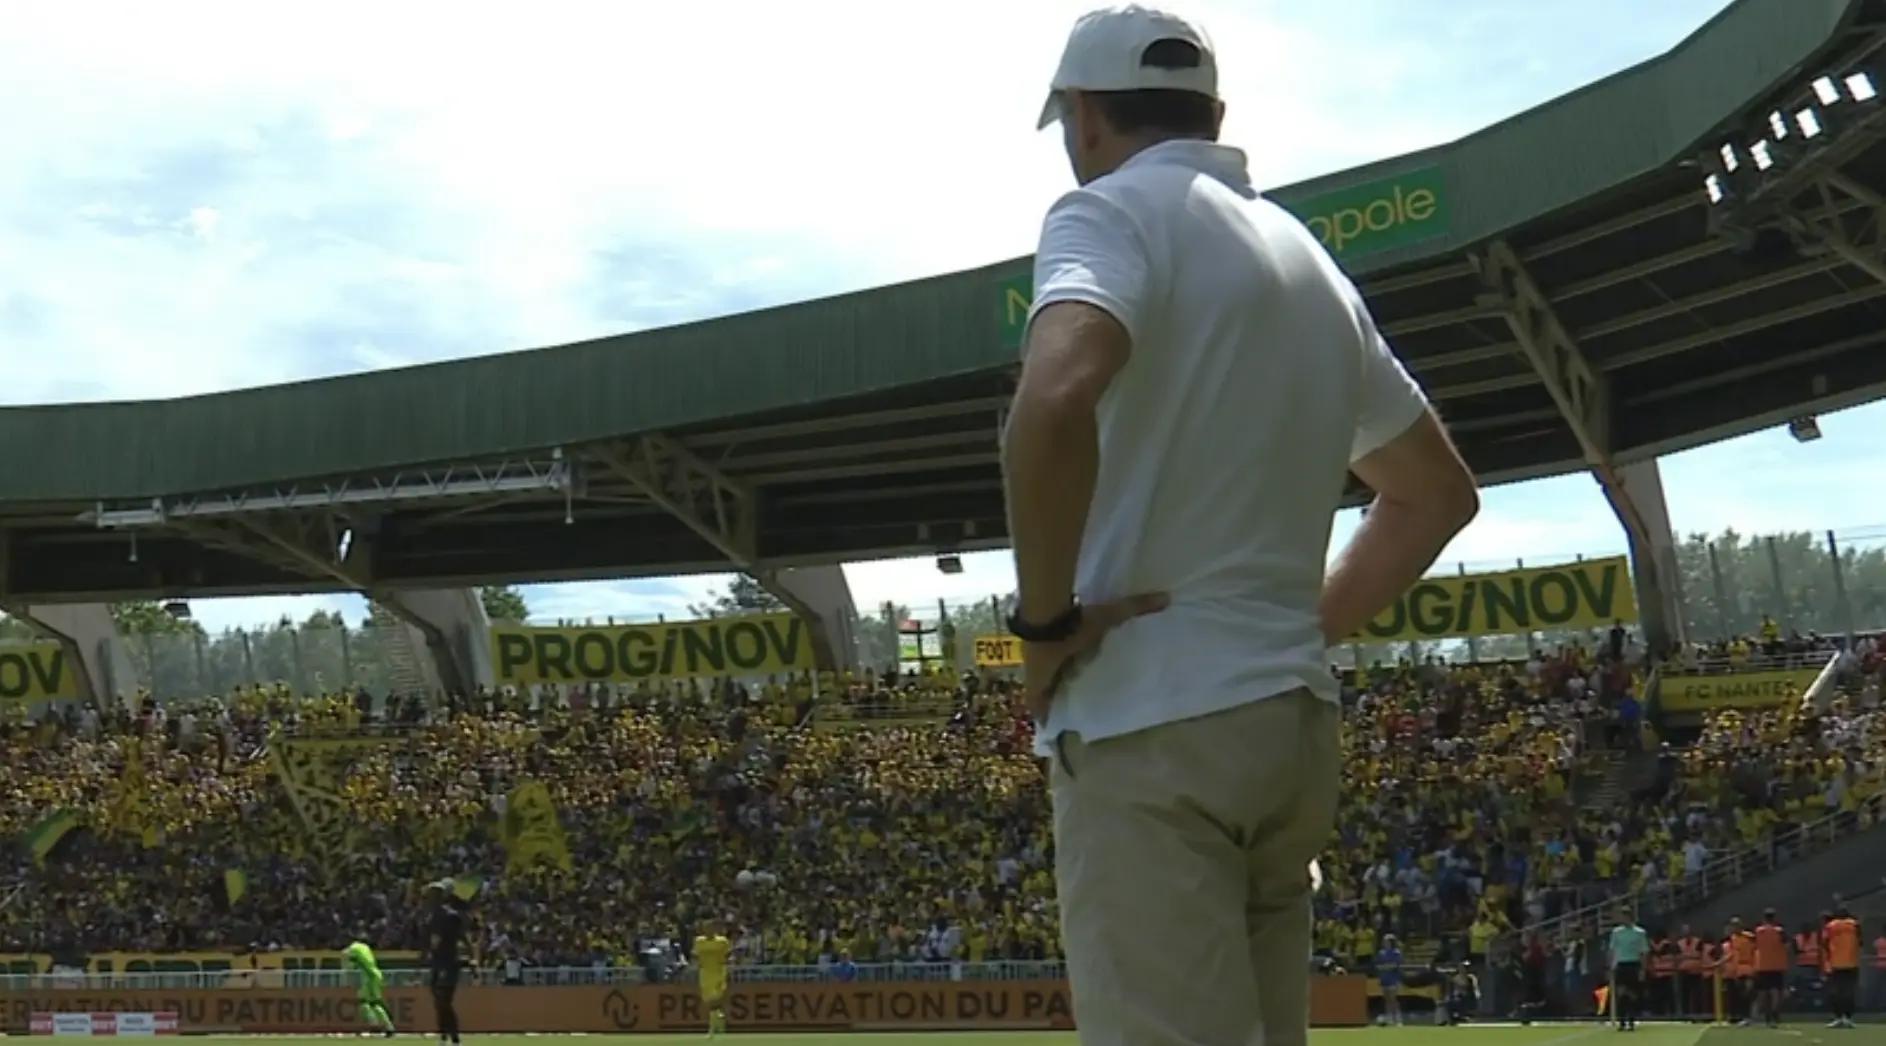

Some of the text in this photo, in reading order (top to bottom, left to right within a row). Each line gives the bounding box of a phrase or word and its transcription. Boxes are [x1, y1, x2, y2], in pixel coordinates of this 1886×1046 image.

[1684, 680, 1795, 699] FC NANTE
[658, 992, 945, 1020] PRSERVATION
[957, 991, 1009, 1020] DU
